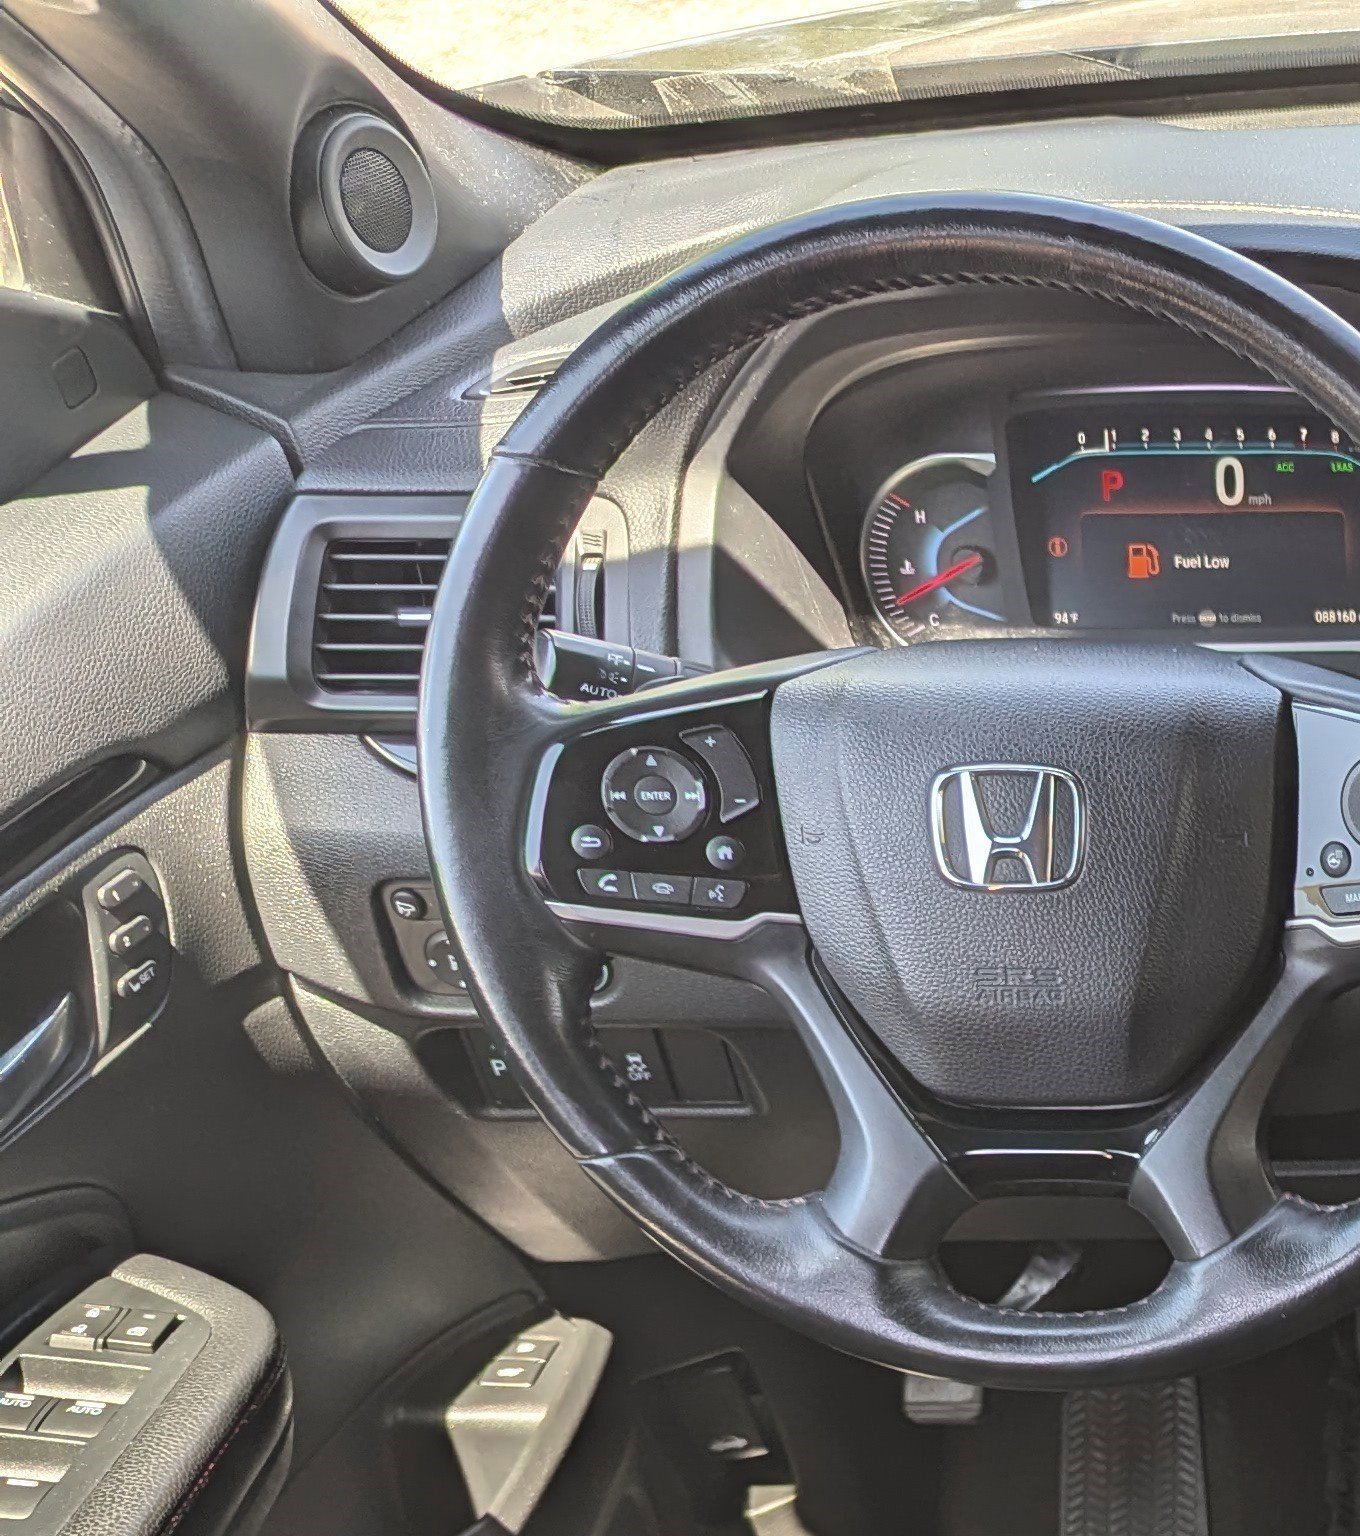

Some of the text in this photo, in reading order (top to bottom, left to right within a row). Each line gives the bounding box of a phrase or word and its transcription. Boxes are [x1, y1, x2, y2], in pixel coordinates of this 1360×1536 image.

[1078, 432, 1085, 444] 0
[1111, 429, 1117, 441] 1
[1141, 428, 1150, 441] 2
[1173, 427, 1181, 441] 3
[1102, 470, 1124, 502] P
[1215, 456, 1272, 506] 0 mph
[915, 510, 926, 524] H
[1174, 554, 1229, 570] Fuel Low
[929, 614, 939, 626] C
[1219, 613, 1229, 623] to
[580, 682, 617, 699] AUTO
[640, 791, 671, 801] ENTER
[66, 1406, 102, 1415] AUTO
